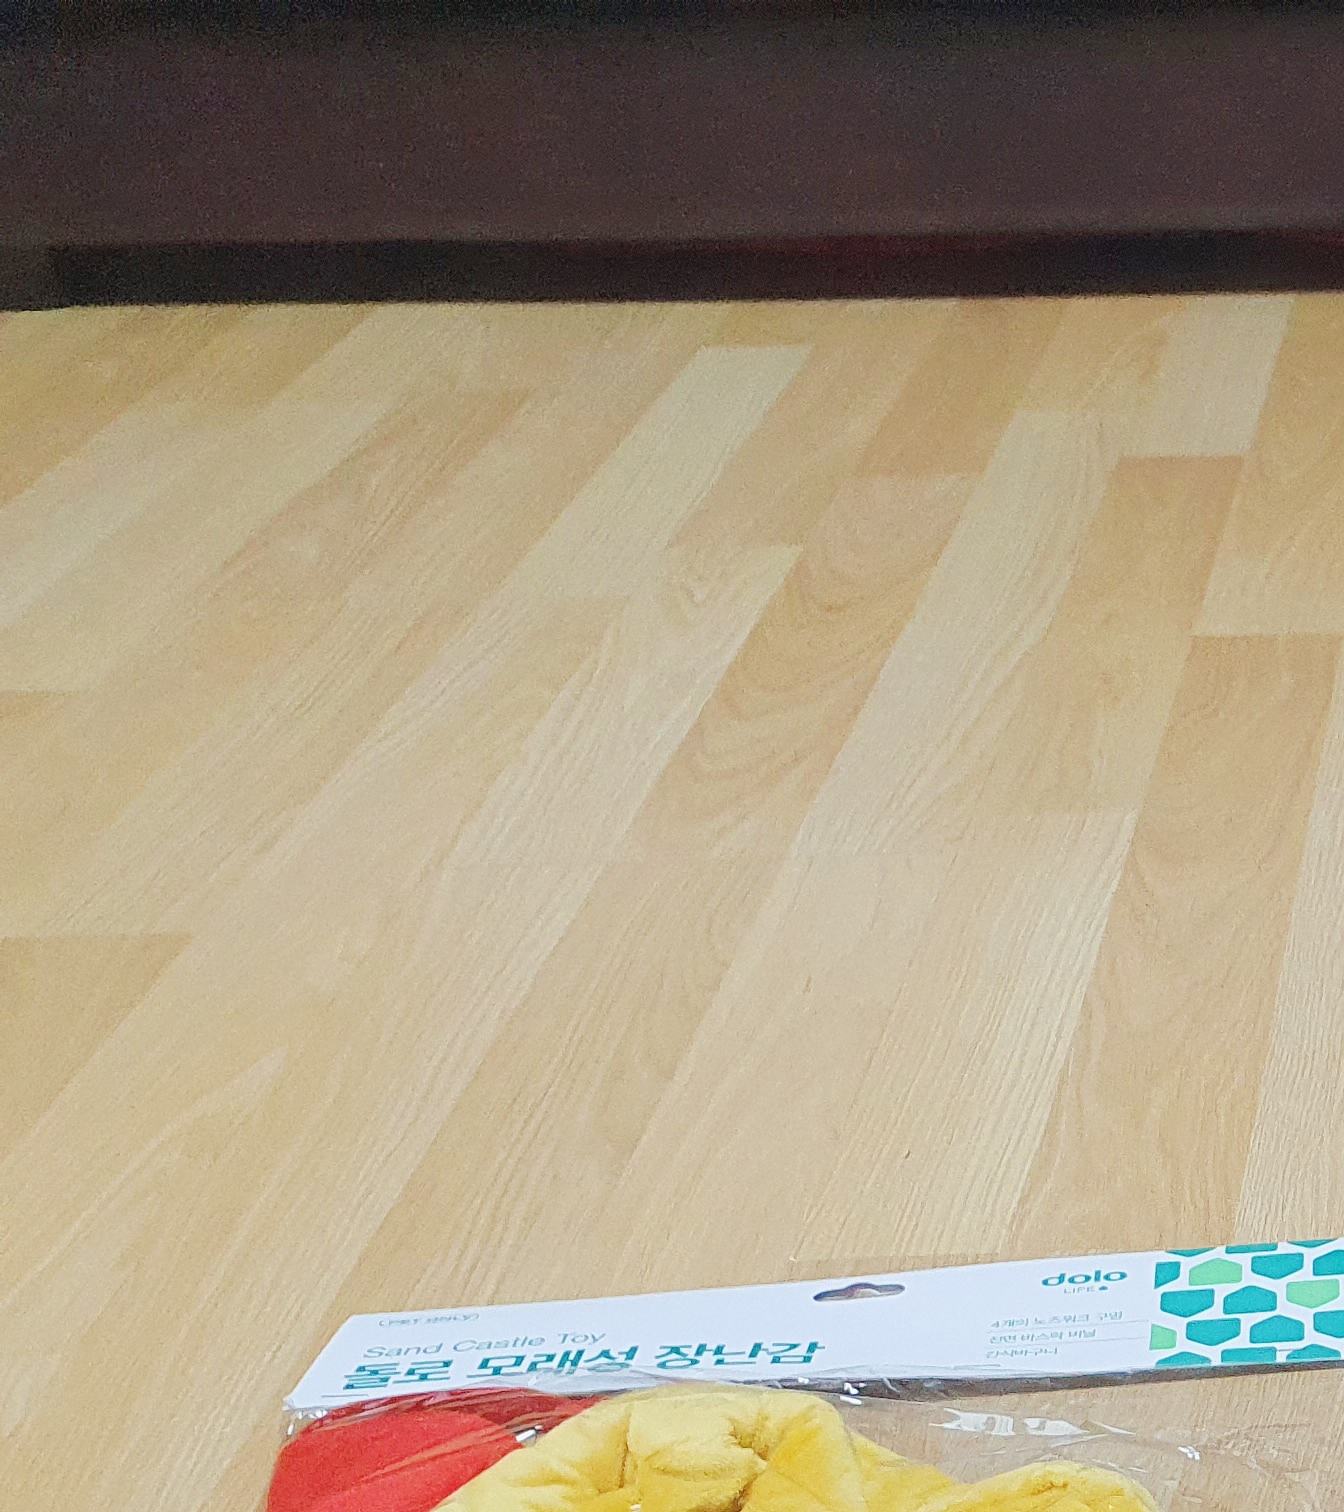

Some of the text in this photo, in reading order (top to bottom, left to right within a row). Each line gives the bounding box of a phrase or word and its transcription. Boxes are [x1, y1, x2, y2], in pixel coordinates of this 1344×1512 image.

[1041, 1269, 1128, 1286] dolo
[363, 1331, 607, 1358] Sand Castle Toy
[343, 1341, 826, 1390] 돌로 모래성 장난감
